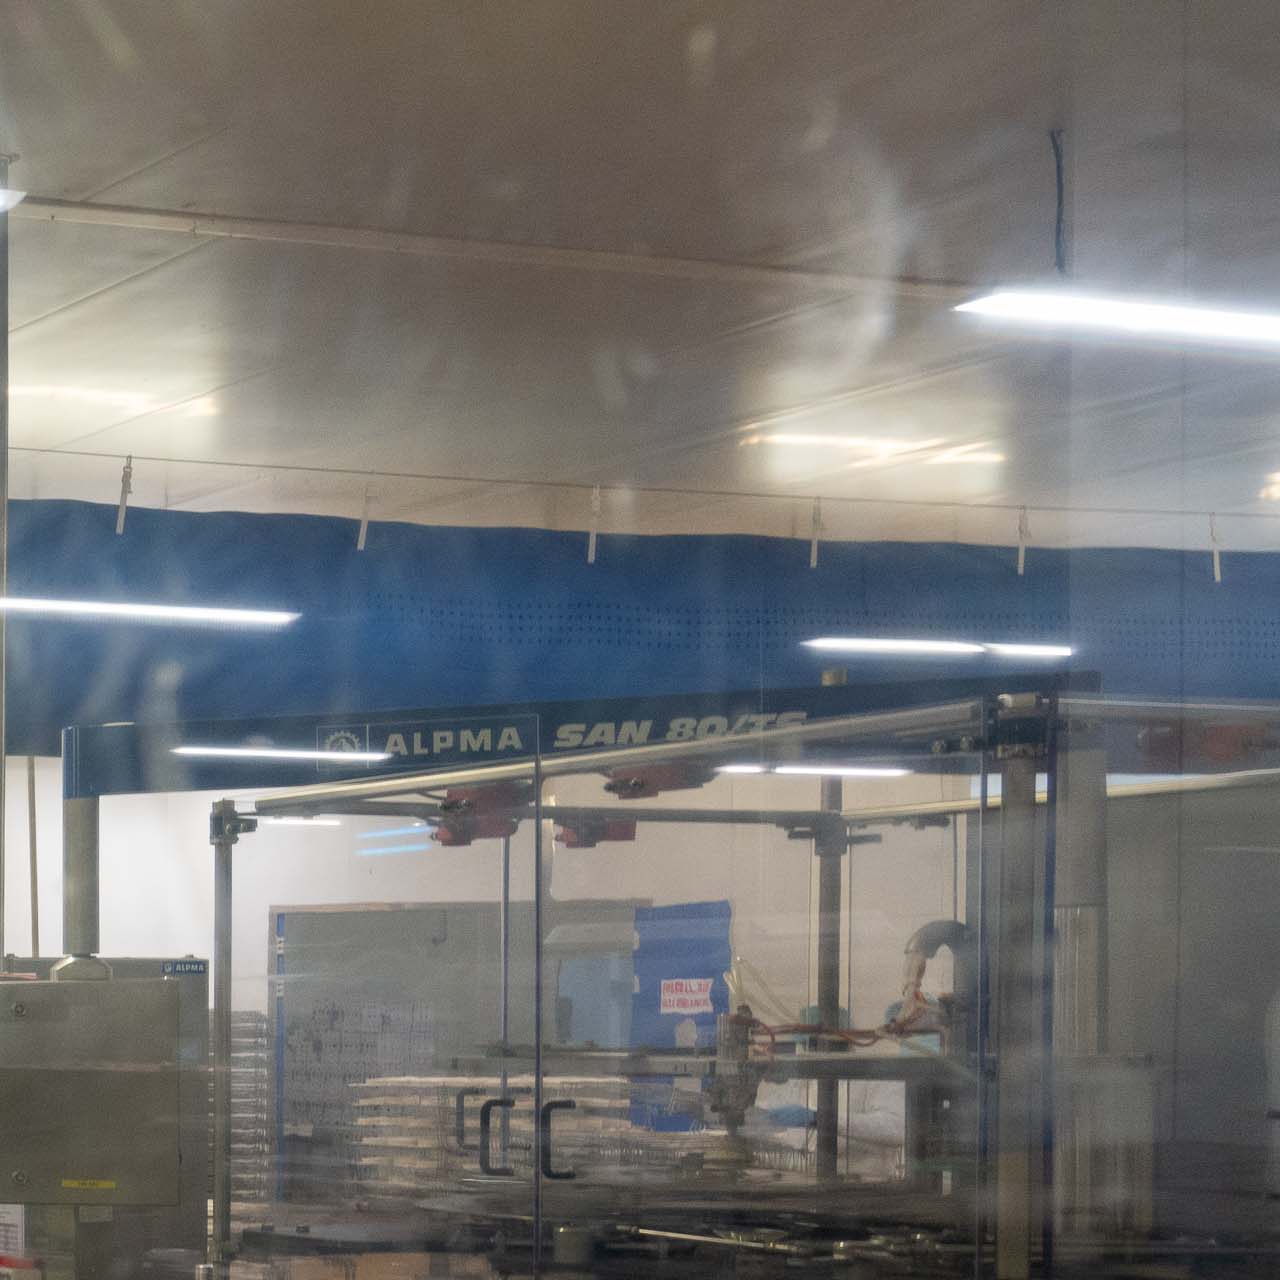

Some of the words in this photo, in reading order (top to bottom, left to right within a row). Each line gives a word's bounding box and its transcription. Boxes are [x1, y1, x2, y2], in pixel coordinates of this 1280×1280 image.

[385, 727, 523, 756] ALPMA
[553, 720, 654, 748] SAN
[175, 963, 204, 972] ALPMA
